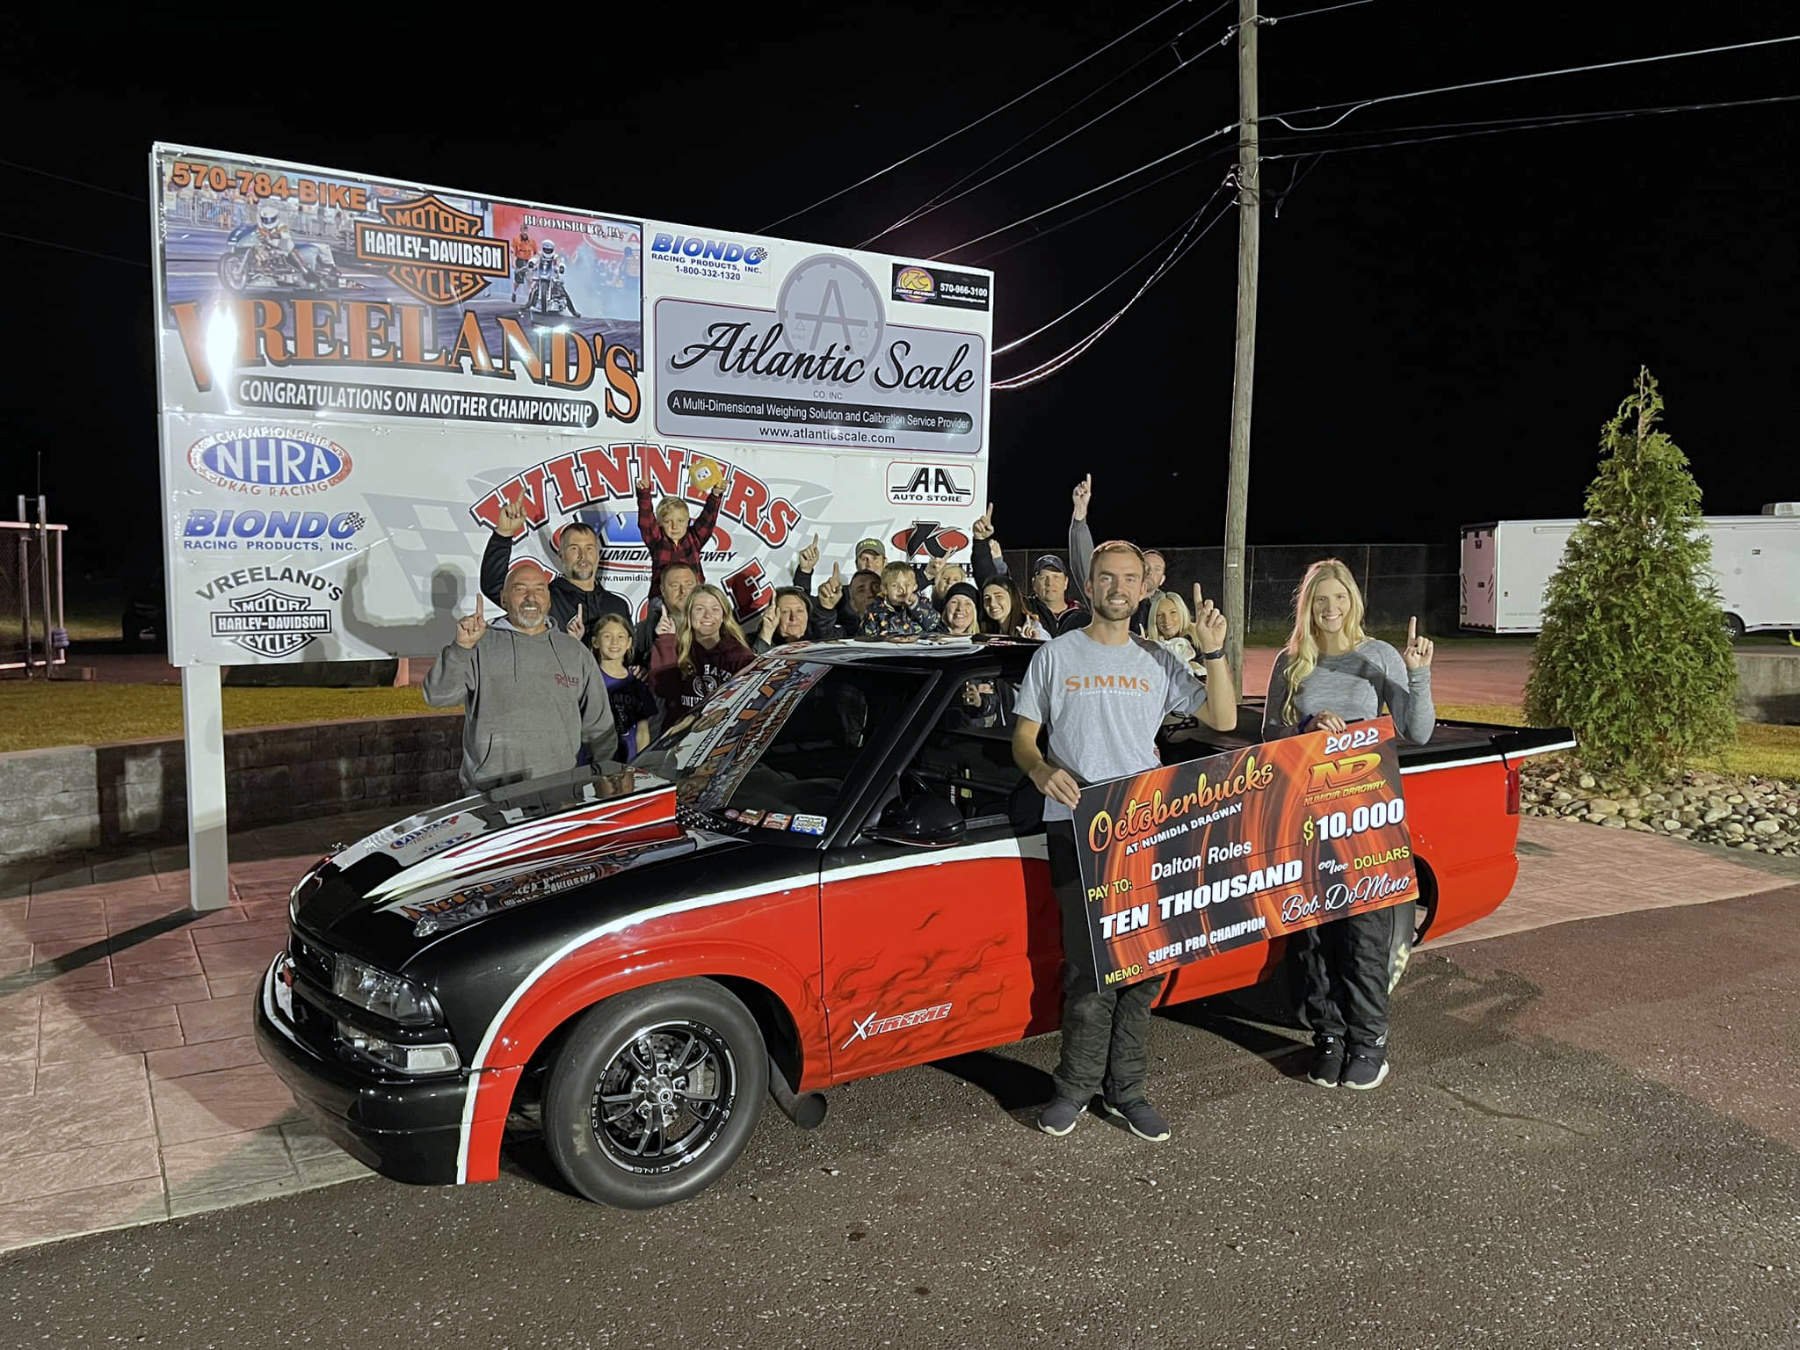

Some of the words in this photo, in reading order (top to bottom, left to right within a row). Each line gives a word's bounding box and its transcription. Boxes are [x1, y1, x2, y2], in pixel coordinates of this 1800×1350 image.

[171, 161, 368, 211] 570-784-BIKE
[395, 204, 470, 235] MOTOR
[364, 230, 502, 269] HARLEY-DAVIDSON
[651, 232, 766, 265] BIONDO
[651, 253, 686, 264] RACING
[690, 258, 740, 272] PRODUCTS,
[744, 265, 762, 274] INC.
[400, 265, 474, 299] CYCLES
[675, 265, 741, 281] 1-800-332-1320
[171, 298, 639, 423] VREELAND'S
[671, 322, 865, 383] Atlantic
[875, 340, 975, 393] Scale
[240, 379, 392, 412] CONGRATULATIONS
[395, 391, 418, 412] ON
[419, 393, 488, 418] ANOTHER
[490, 399, 593, 424] CHAMPIONSHIP
[672, 396, 680, 409] A
[683, 397, 764, 415] Multi-Dimensional
[766, 404, 807, 420] Weighing
[809, 407, 843, 420] Solution
[845, 411, 861, 421] and
[862, 411, 906, 425] Calibration
[907, 415, 935, 427] Service
[937, 416, 969, 429] Provider
[759, 427, 895, 444] www.atlanticscale.com
[216, 438, 331, 483] NHRA
[216, 476, 262, 496] DRAG
[269, 482, 328, 497] RACING
[926, 495, 962, 503] STORE
[183, 509, 364, 540] BIONDO
[184, 540, 238, 550] RACING
[247, 540, 323, 552] PRODUCTS,
[331, 541, 358, 551] INC.
[196, 566, 343, 602] VREELAND'S
[242, 595, 300, 612] MOTOR
[218, 615, 325, 631] HARLEY-DAVIDSON
[244, 634, 303, 653] CYCLES
[1065, 675, 1150, 693] SIMMS
[1324, 727, 1379, 755] 2022
[1307, 752, 1382, 794] ND
[1089, 755, 1274, 853] Octoberbucks
[1125, 841, 1140, 856] AT
[1141, 823, 1189, 849] NUMIDIA
[1190, 802, 1243, 832] DRAGWAY
[1088, 882, 1110, 902] PAY
[1112, 878, 1133, 896] TO:
[1151, 852, 1201, 882] Dalton
[1208, 840, 1253, 865] Roles
[1100, 904, 1149, 940] TEN
[1158, 860, 1303, 922] THOUSAND
[1354, 846, 1410, 870] DOLLARS
[1281, 894, 1321, 923] Bob
[1105, 963, 1144, 985] MEMO:
[1148, 942, 1183, 965] SUPER
[1185, 935, 1208, 955] PRO
[1209, 916, 1266, 945] CHAMPION
[841, 1002, 953, 1050] XTREME
